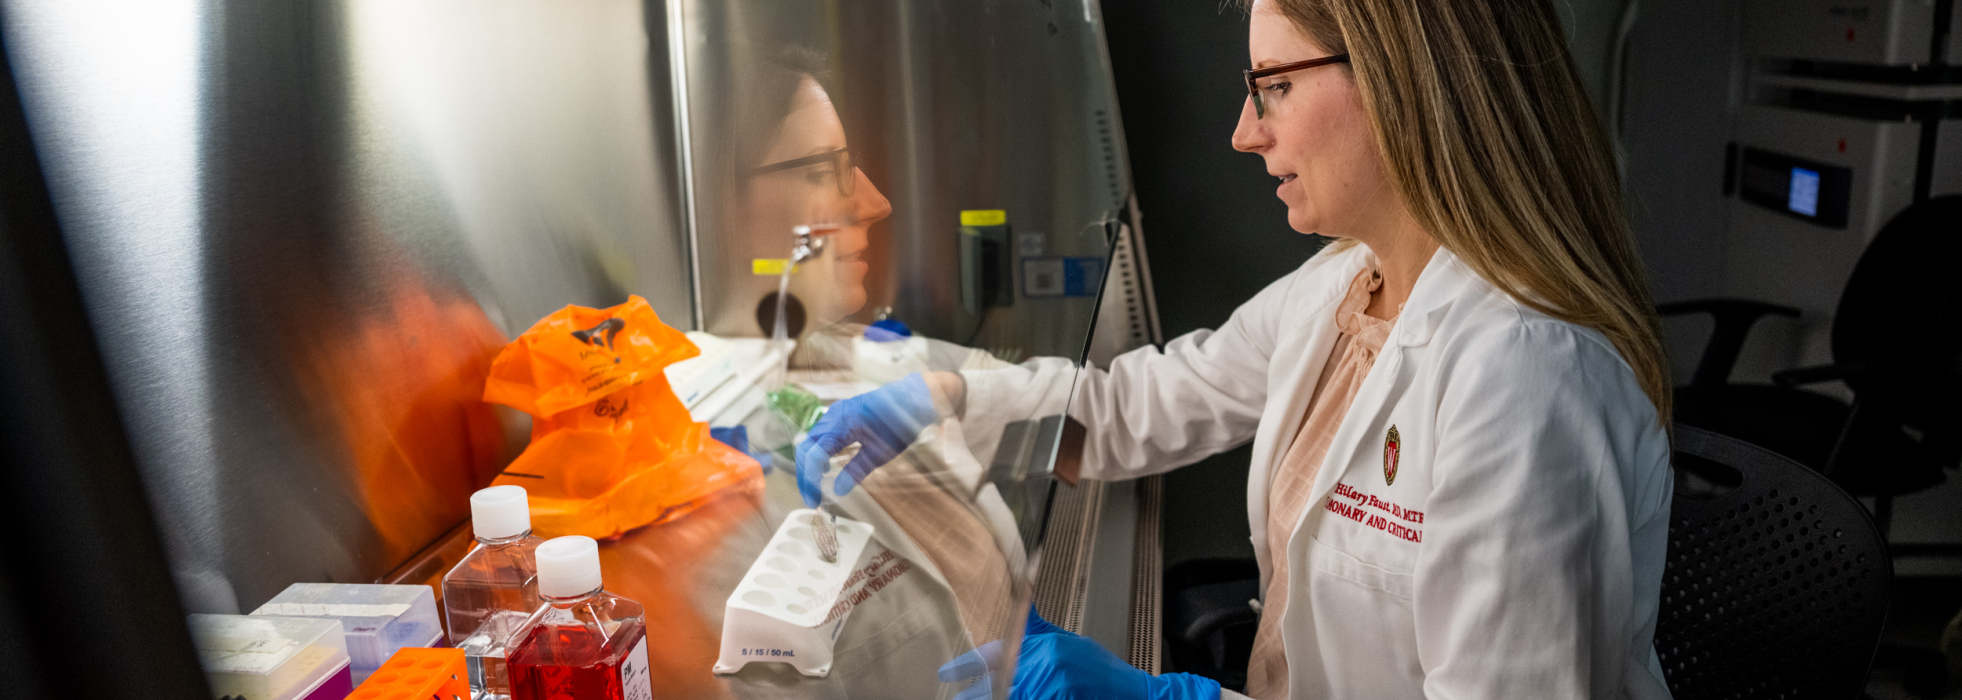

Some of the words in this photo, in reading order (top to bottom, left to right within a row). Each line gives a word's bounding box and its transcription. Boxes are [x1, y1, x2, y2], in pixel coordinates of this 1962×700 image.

[1334, 482, 1368, 506] Hilary
[1368, 494, 1390, 513] Faust,
[1325, 496, 1367, 523] ONARY
[1366, 514, 1387, 531] AND
[742, 648, 748, 656] 5
[755, 648, 764, 656] 15
